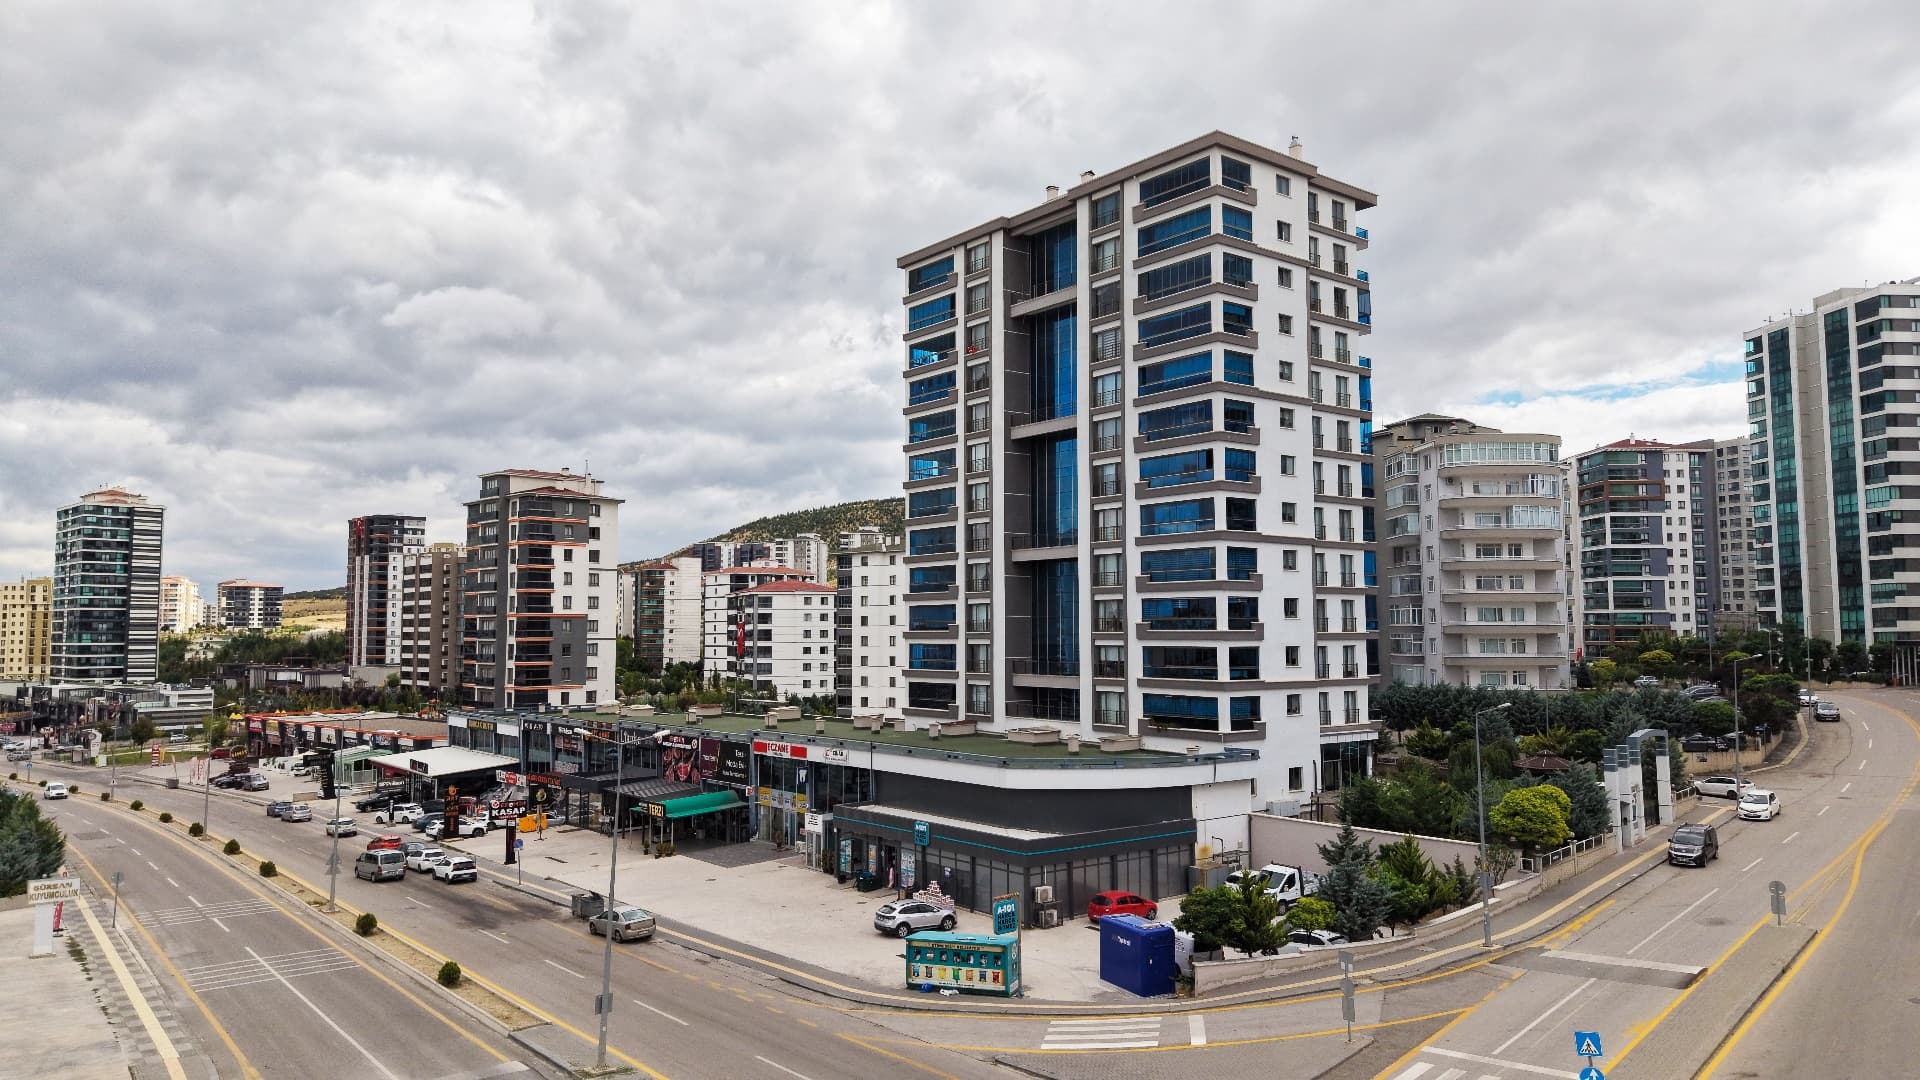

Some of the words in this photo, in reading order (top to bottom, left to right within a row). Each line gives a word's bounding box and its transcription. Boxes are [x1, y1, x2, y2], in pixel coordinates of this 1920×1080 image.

[767, 742, 789, 753] ECZANE
[492, 807, 526, 817] KASAP
[30, 889, 79, 901] KUYUMCULUK
